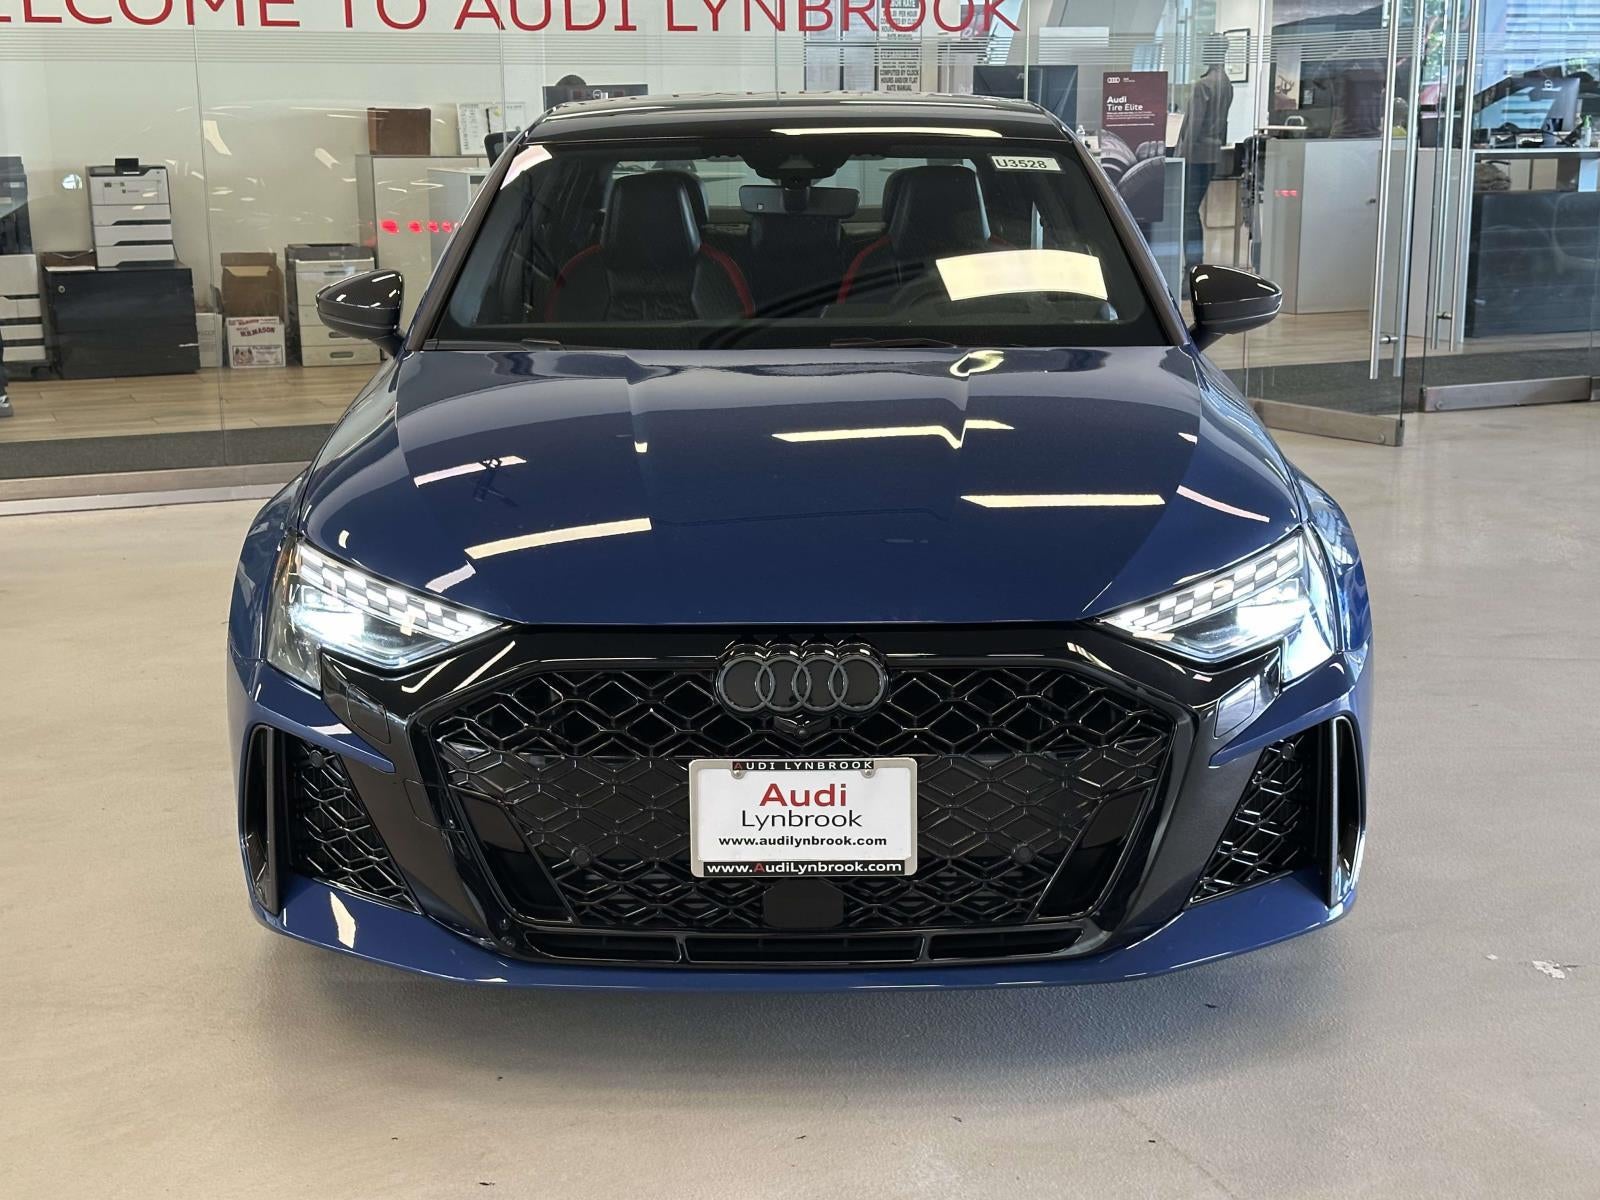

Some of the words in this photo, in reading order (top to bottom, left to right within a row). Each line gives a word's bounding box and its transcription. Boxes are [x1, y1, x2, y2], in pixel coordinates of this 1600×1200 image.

[453, 0, 637, 31] AUDI
[666, 0, 1021, 32] LYNBROOK
[1106, 96, 1127, 104] Audi
[995, 159, 1047, 168] U3528
[733, 761, 776, 770] AUDI
[784, 761, 873, 770] LYNBROOK
[759, 783, 847, 807] Audi
[742, 809, 862, 831] Lynbrook
[719, 835, 887, 848] www.audilynbrook.com
[707, 860, 902, 875] www.AudiLynbrook.com
